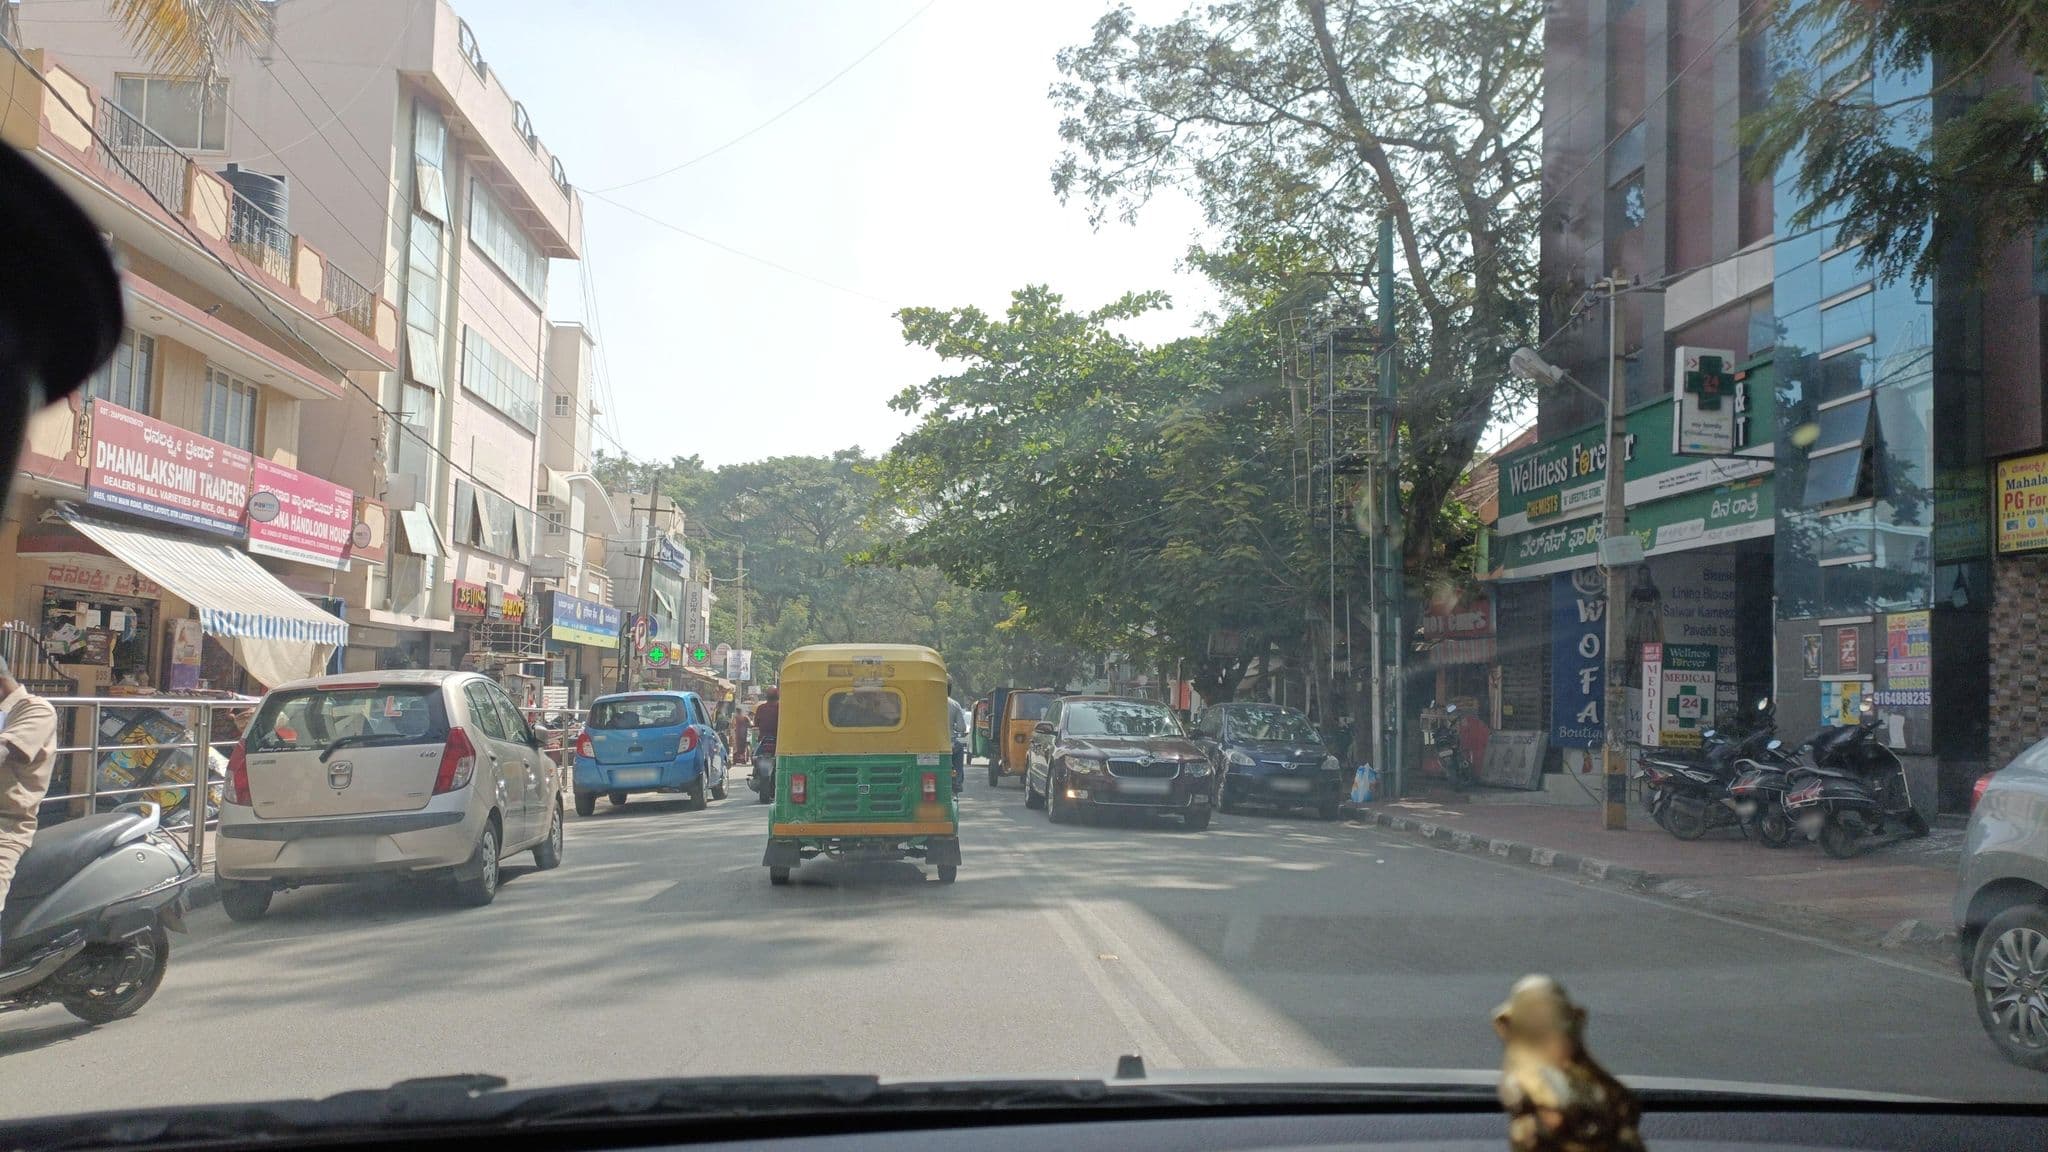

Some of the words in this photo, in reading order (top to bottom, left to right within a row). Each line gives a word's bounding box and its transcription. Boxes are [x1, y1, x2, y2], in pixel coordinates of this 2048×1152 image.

[1735, 382, 1745, 413] &
[96, 440, 196, 494] DHANALAKSHMI
[199, 471, 246, 508] TRADERS
[1508, 456, 1568, 497] Wellness
[1571, 434, 1635, 478] Foreer
[103, 475, 136, 492] DEALERS
[137, 484, 145, 495] IN
[146, 485, 159, 498] ALL
[160, 490, 191, 507] VARIETIES
[191, 498, 200, 510] OF
[2004, 491, 2024, 511] PG
[2029, 494, 2047, 508] For
[1527, 494, 1559, 518] CHEMISTS
[290, 514, 329, 540] HANDLOOM
[328, 525, 351, 545] HOUSE
[1669, 648, 1711, 658] Wellness
[1672, 657, 1706, 668] Forever
[1664, 673, 1714, 684] MEDICAL
[384, 696, 402, 717] L
[1647, 664, 1657, 744] MEDICAL
[1681, 697, 1699, 709] 24
[1873, 691, 1931, 706] 9164888235
[1559, 726, 1601, 739] Boutiq
